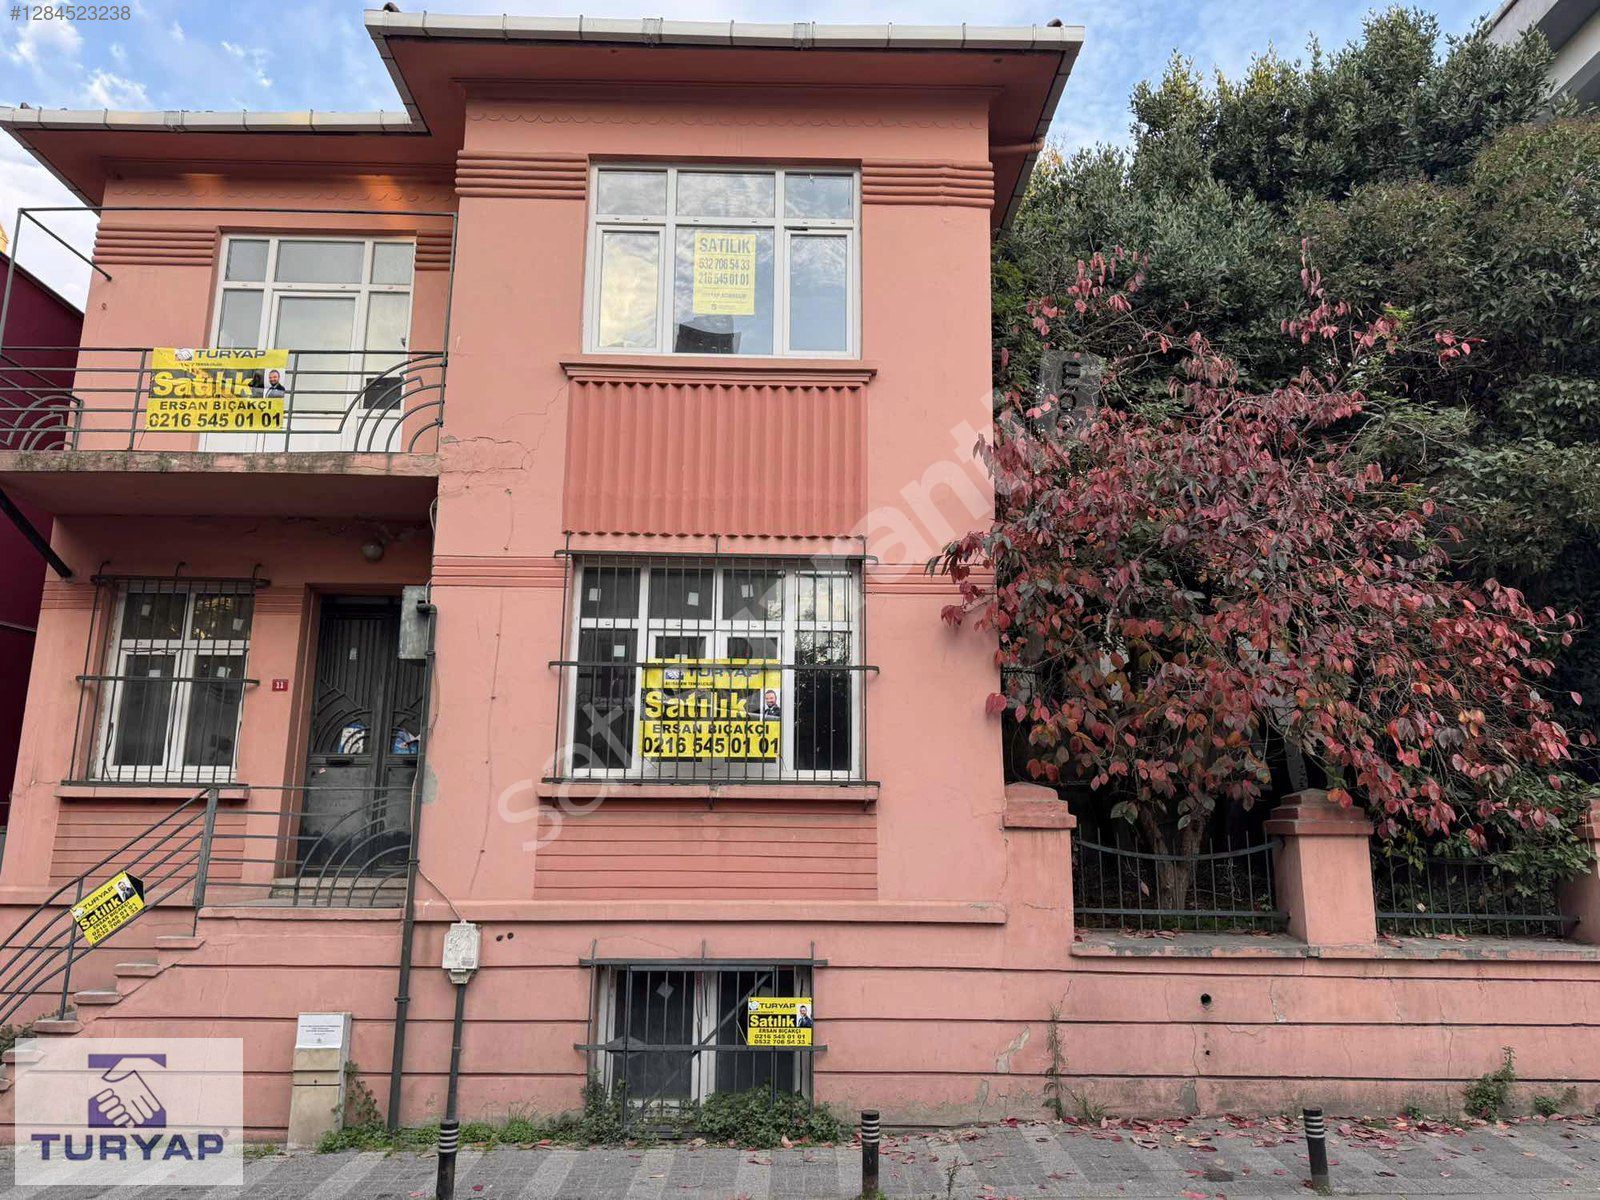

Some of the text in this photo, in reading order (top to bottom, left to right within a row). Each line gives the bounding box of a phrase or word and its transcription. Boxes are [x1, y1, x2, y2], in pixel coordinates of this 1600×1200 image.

[700, 237, 751, 254] SATILIK
[196, 350, 266, 358] TURYAP
[160, 401, 208, 410] ERSAN
[149, 412, 280, 428] 0216 545 01 01
[276, 681, 284, 689] 11
[645, 691, 747, 718] Satılık
[653, 724, 703, 734] ERSAN
[643, 737, 778, 753] 0216 545 01 01
[83, 885, 114, 909] TURYAP
[750, 1015, 795, 1027] Satılık
